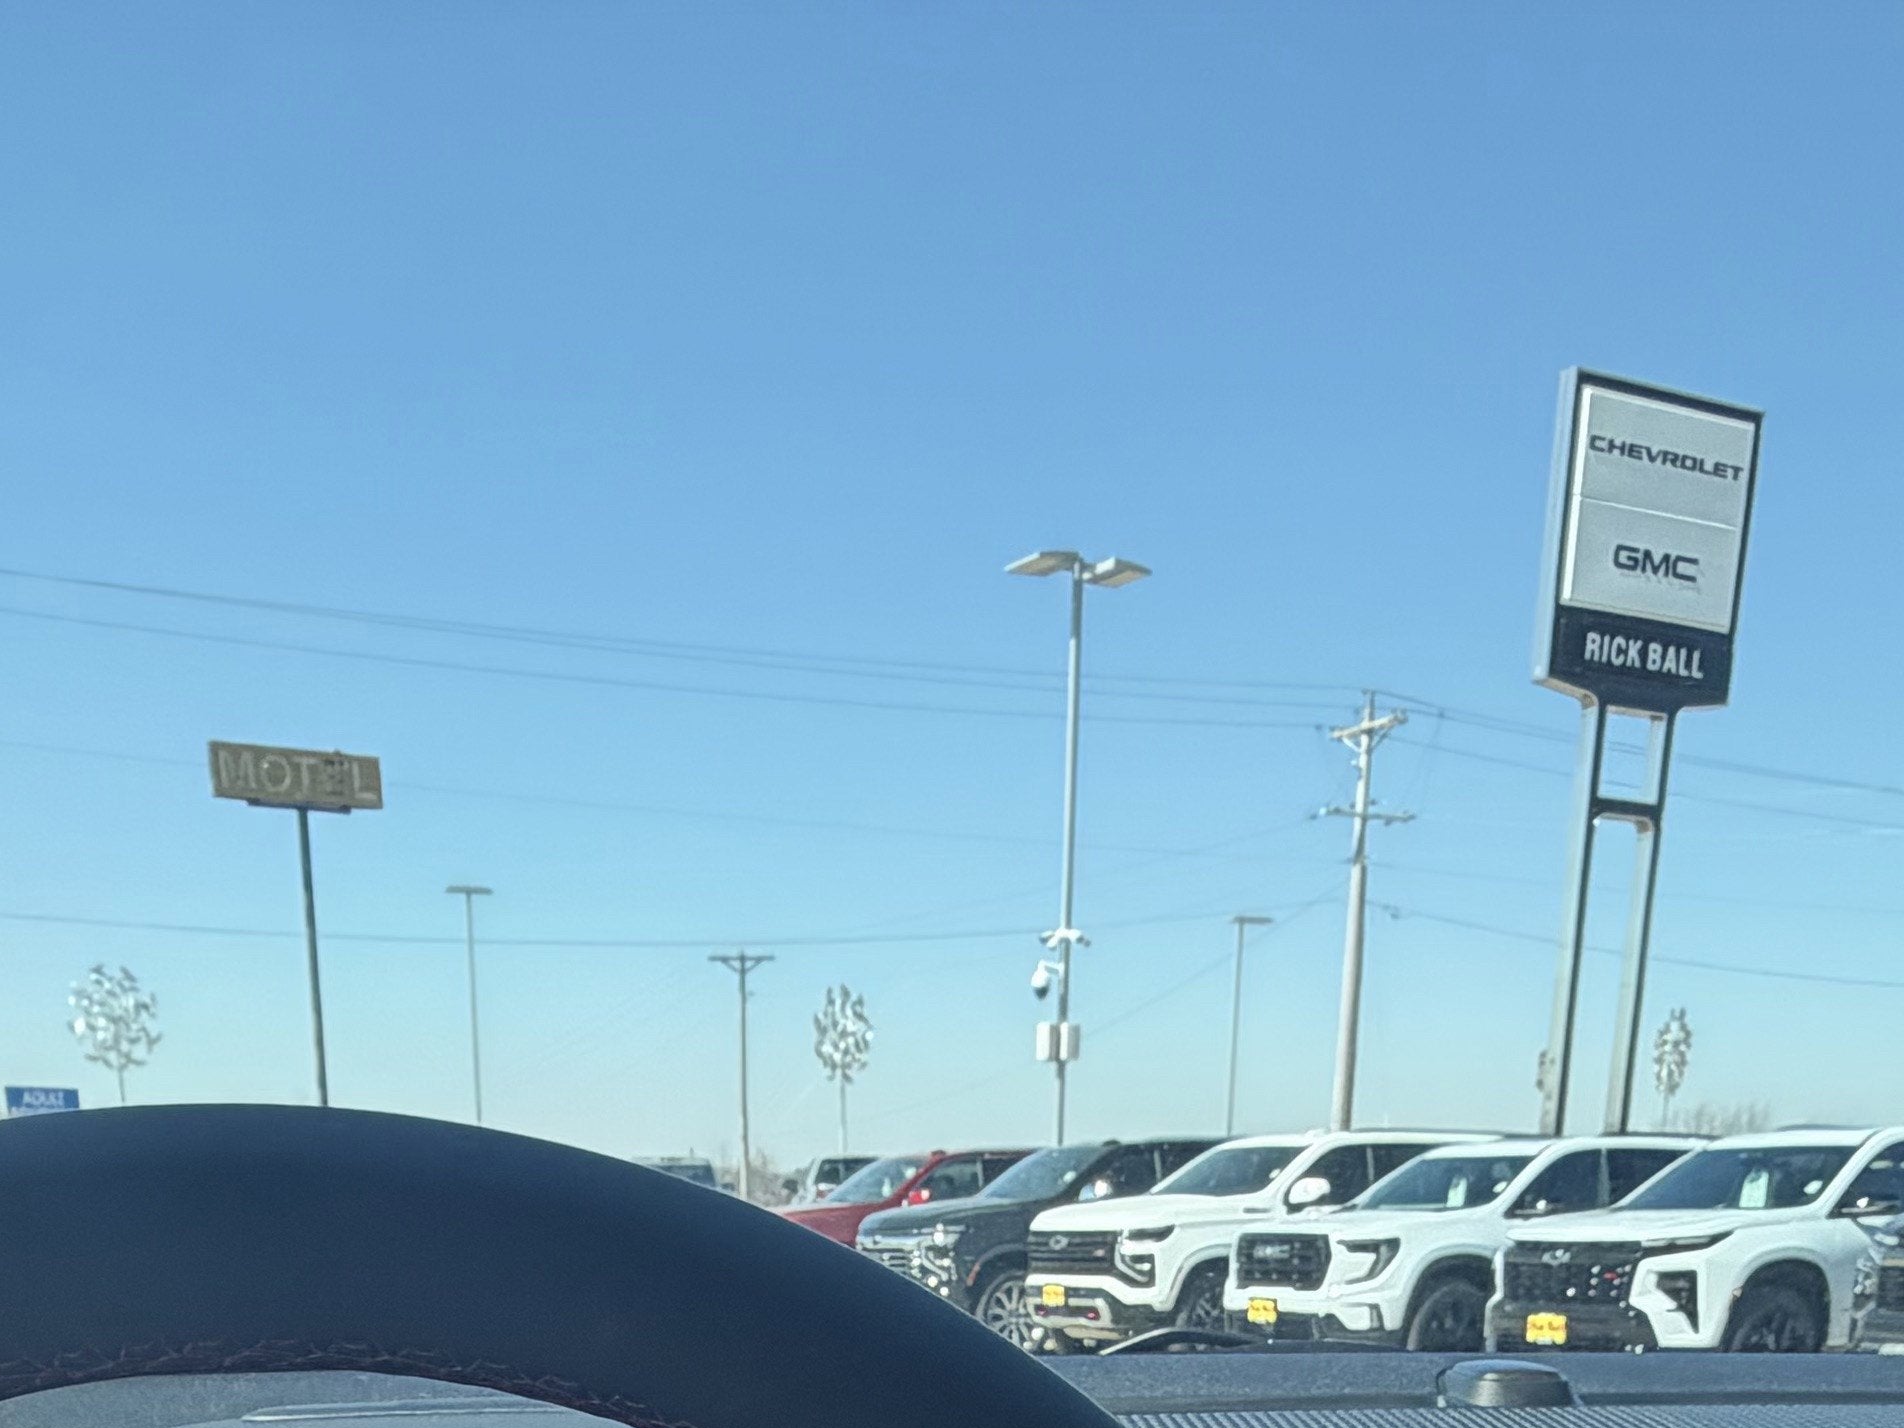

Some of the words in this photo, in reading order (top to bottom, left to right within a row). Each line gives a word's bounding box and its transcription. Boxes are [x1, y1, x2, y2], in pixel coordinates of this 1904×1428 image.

[1589, 435, 1743, 481] CHEVROLET
[1614, 544, 1700, 583] GMC
[1584, 632, 1641, 668] RICK
[1647, 647, 1705, 679] BALL
[217, 749, 378, 799] MOTEL
